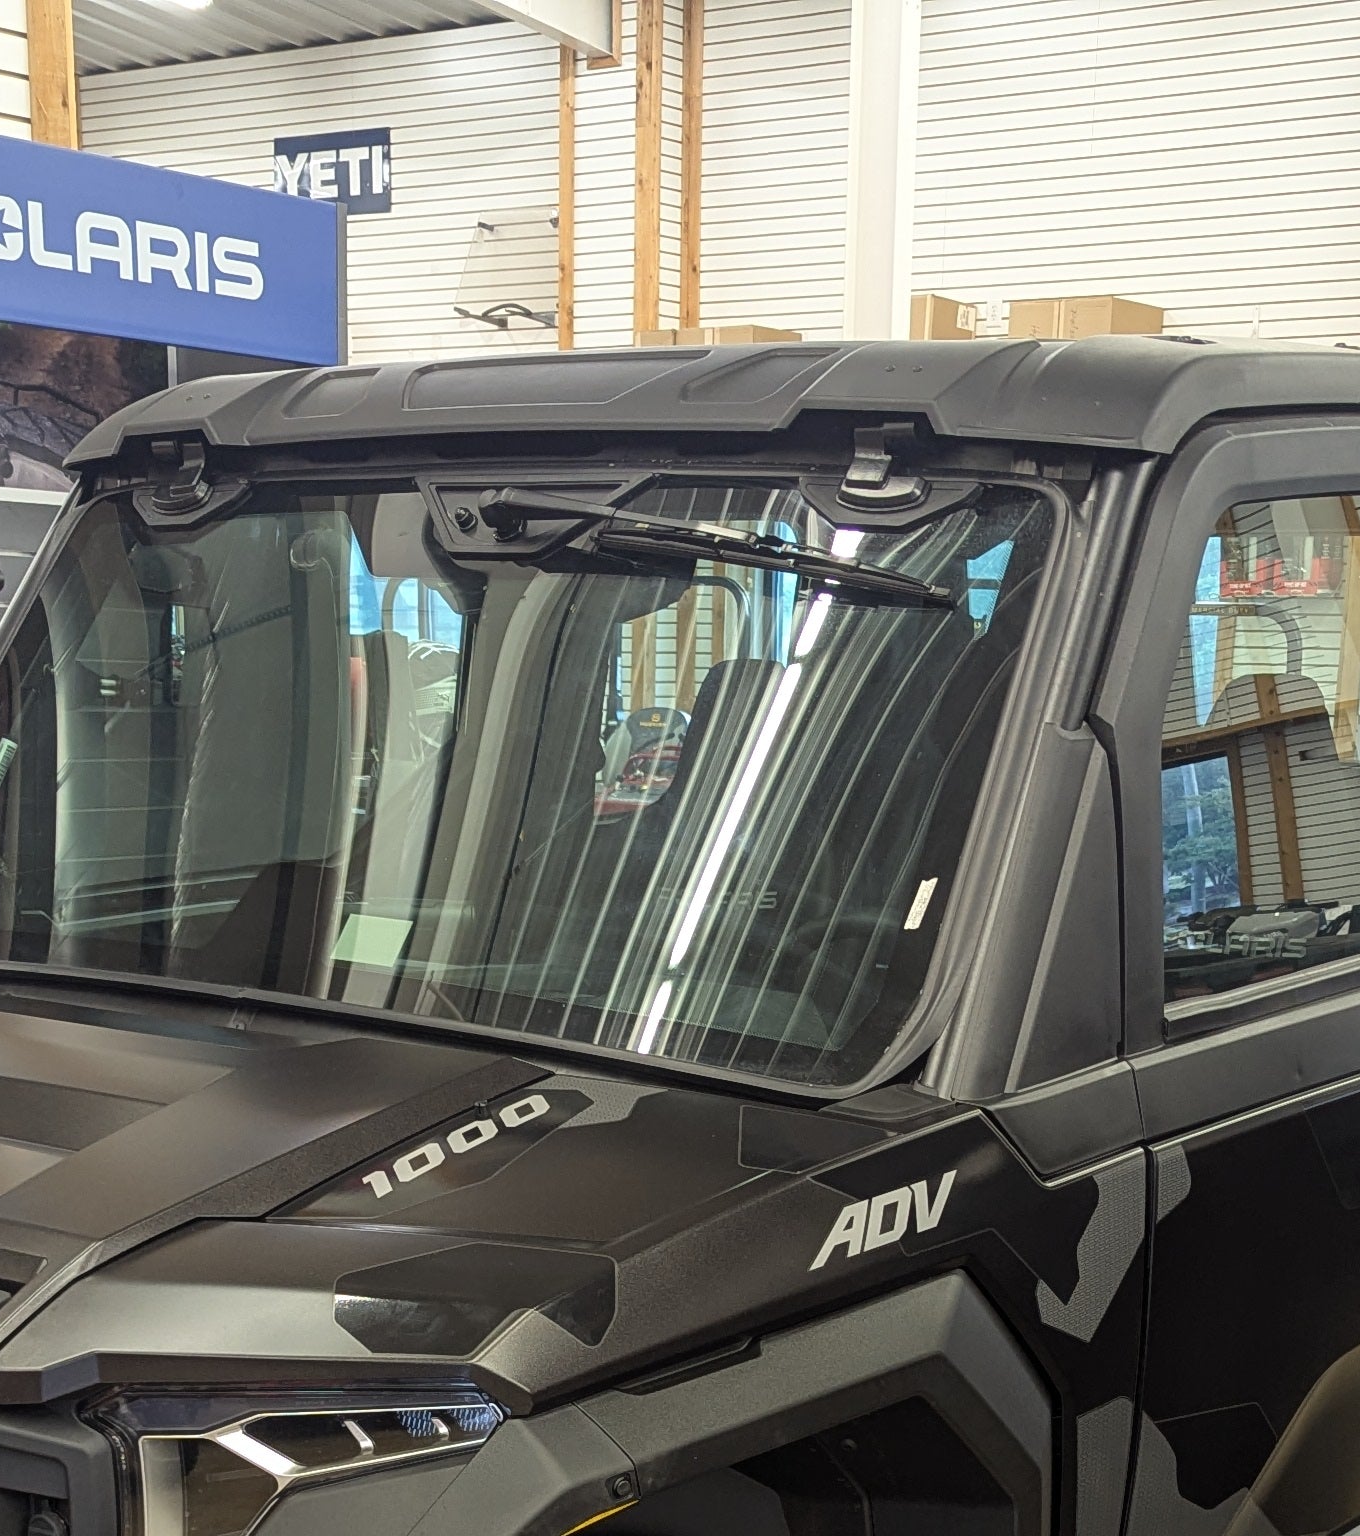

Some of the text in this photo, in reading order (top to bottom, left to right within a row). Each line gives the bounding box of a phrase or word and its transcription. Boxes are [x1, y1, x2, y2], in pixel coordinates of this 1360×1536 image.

[276, 145, 383, 199] YETI
[362, 1094, 550, 1198] 1000
[808, 1170, 957, 1271] ADV
